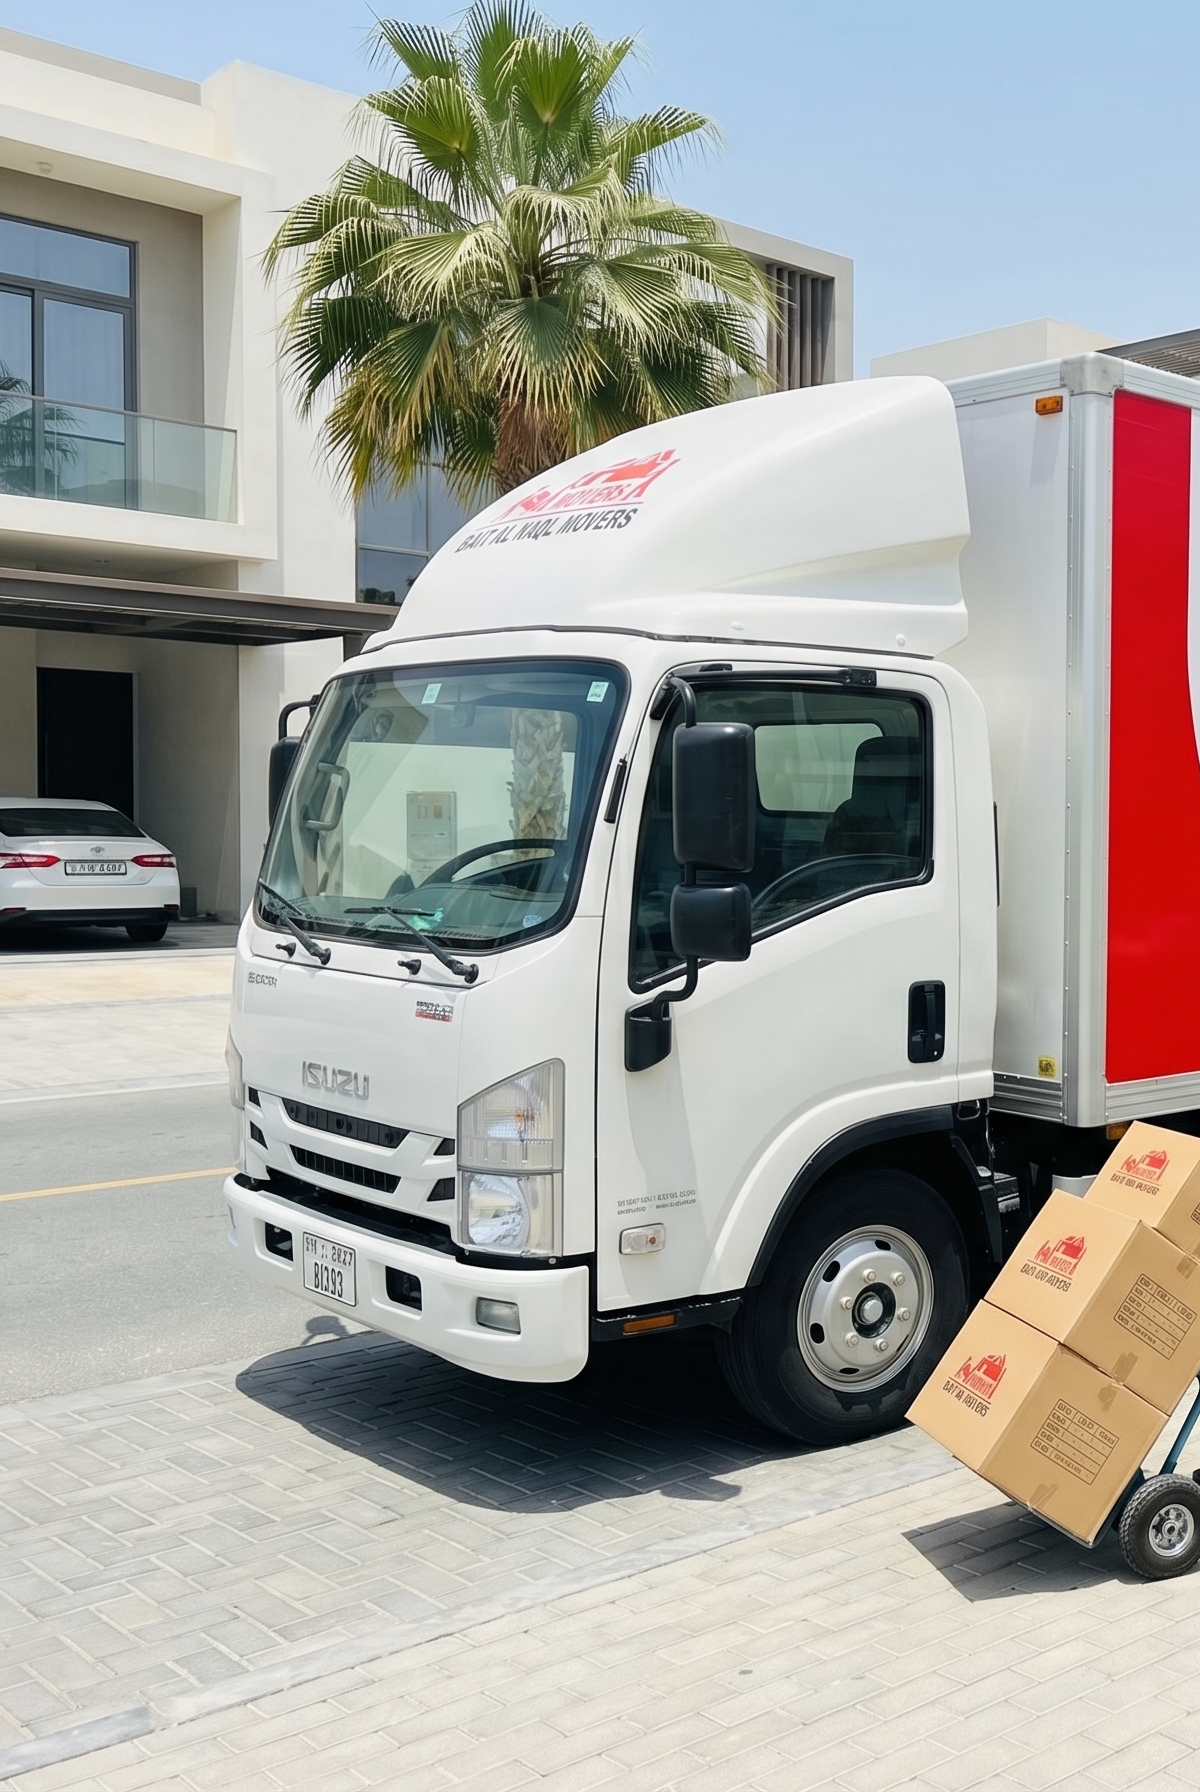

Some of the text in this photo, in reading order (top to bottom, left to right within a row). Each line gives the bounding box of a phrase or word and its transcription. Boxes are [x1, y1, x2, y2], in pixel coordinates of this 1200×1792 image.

[455, 528, 498, 553] BAIT
[512, 517, 559, 541] NAQL
[556, 508, 638, 535] MOVERS
[302, 1060, 370, 1101] ISUZU
